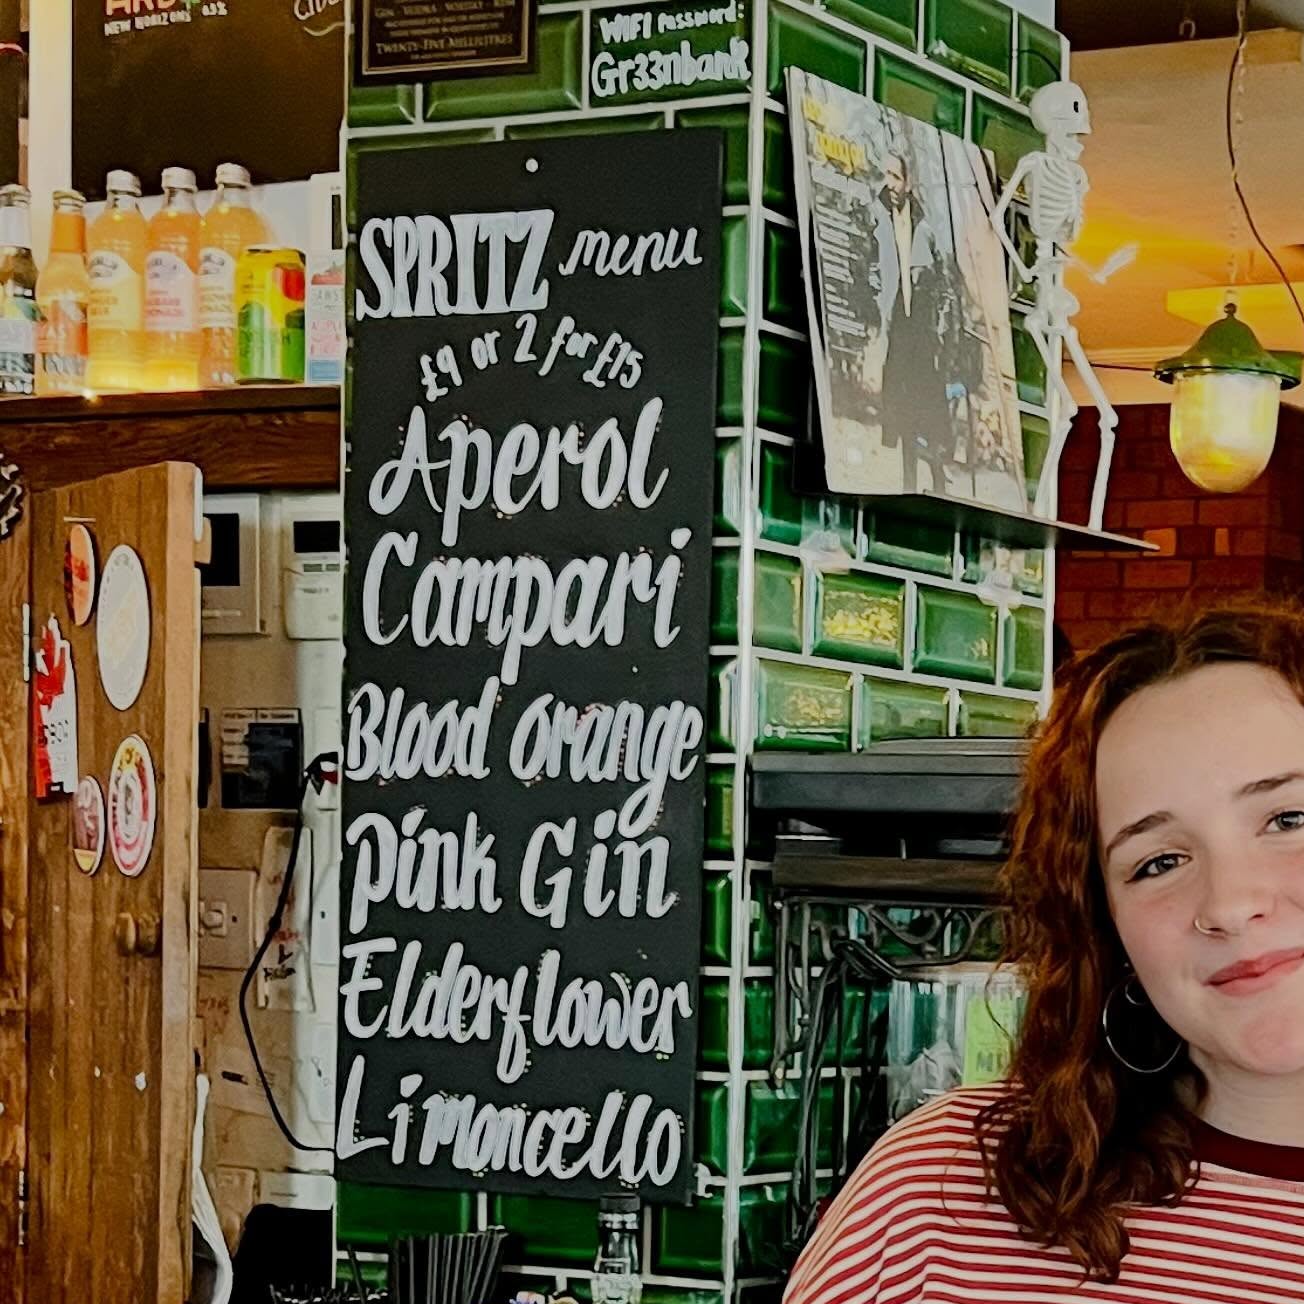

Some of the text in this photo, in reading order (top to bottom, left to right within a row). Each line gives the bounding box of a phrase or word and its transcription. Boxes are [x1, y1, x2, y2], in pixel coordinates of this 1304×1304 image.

[355, 209, 702, 321] SPRITZ menu
[420, 313, 644, 402] £9 or 2 for £15
[368, 397, 670, 547] Aperol
[363, 527, 692, 685] Campari
[346, 676, 499, 782] Blood
[519, 809, 680, 929] Gin
[340, 937, 693, 1084] Elderflower
[336, 1055, 682, 1187] Limoncello
